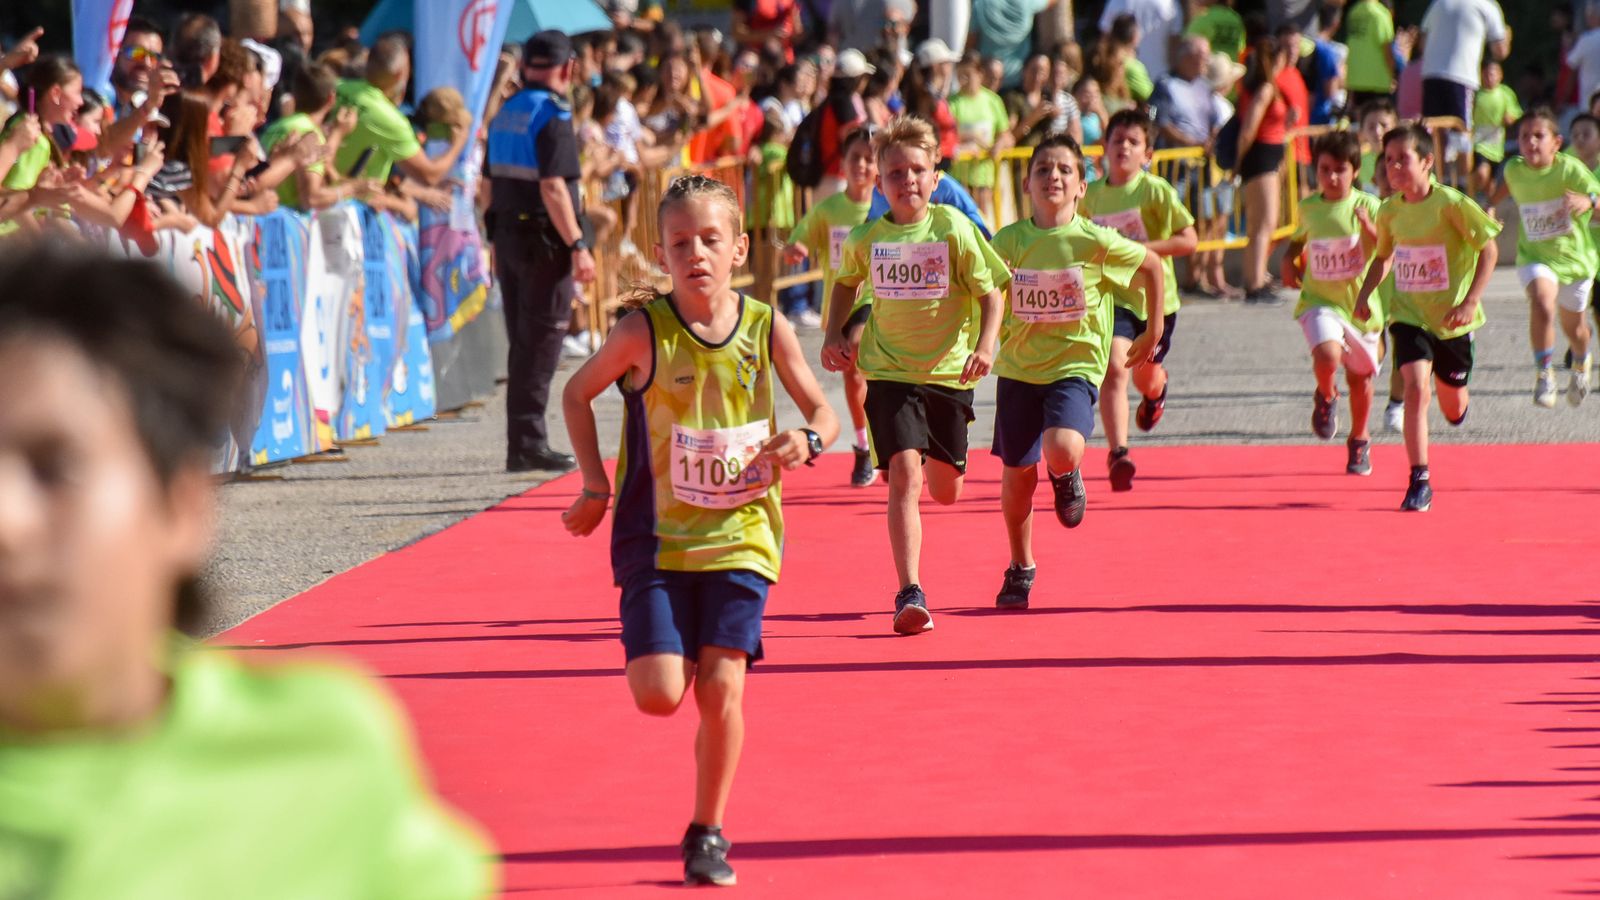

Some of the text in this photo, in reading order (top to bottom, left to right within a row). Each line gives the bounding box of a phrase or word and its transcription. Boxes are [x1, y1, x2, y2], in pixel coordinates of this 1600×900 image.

[1314, 253, 1346, 270] 1011
[1398, 263, 1428, 279] 1074
[876, 263, 922, 284] 1490
[1016, 288, 1060, 309] 1403
[679, 455, 741, 487] 1109
